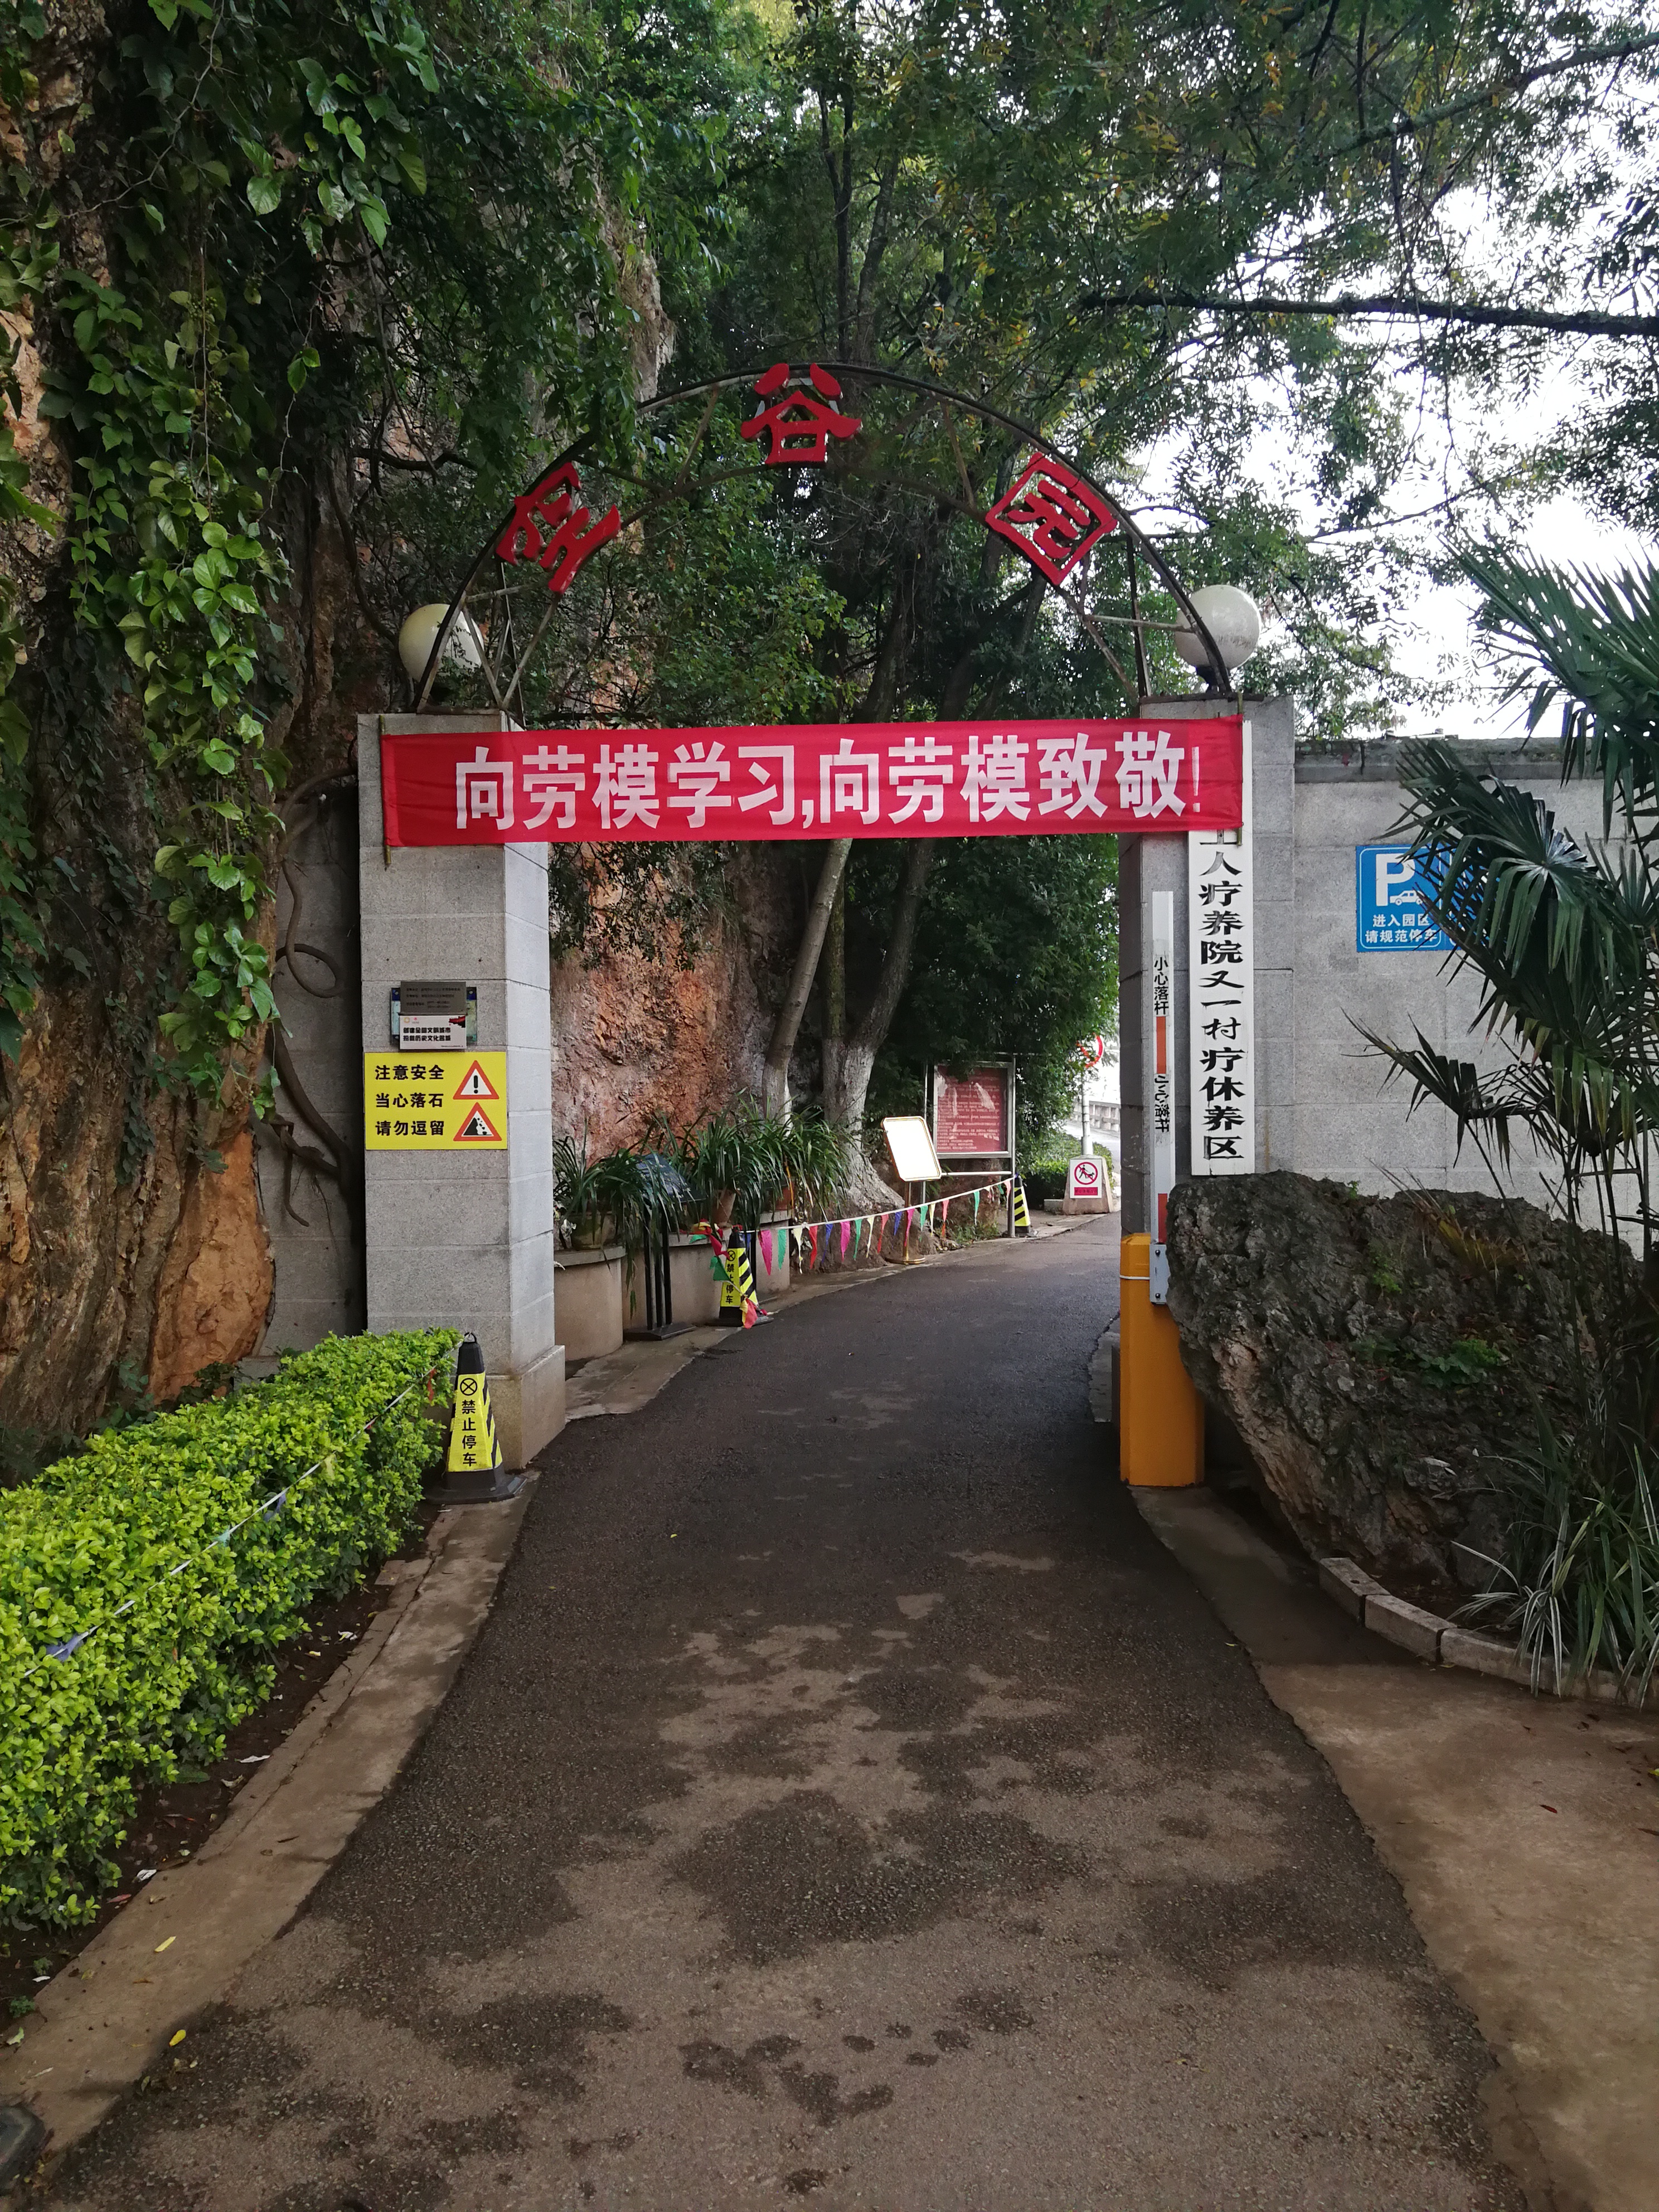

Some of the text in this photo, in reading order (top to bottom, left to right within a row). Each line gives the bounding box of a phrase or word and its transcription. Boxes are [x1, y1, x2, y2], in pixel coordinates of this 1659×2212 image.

[1375, 853, 1415, 906] P
[1372, 914, 1430, 927] 进入园区
[1365, 929, 1438, 943] 请规范停车
[1154, 957, 1169, 1015] 小心落杆
[375, 1064, 444, 1080] 注意安全
[375, 1093, 444, 1108] 当心落石
[375, 1120, 444, 1136] 请勿逗留
[462, 1399, 477, 1467] 禁止停车
